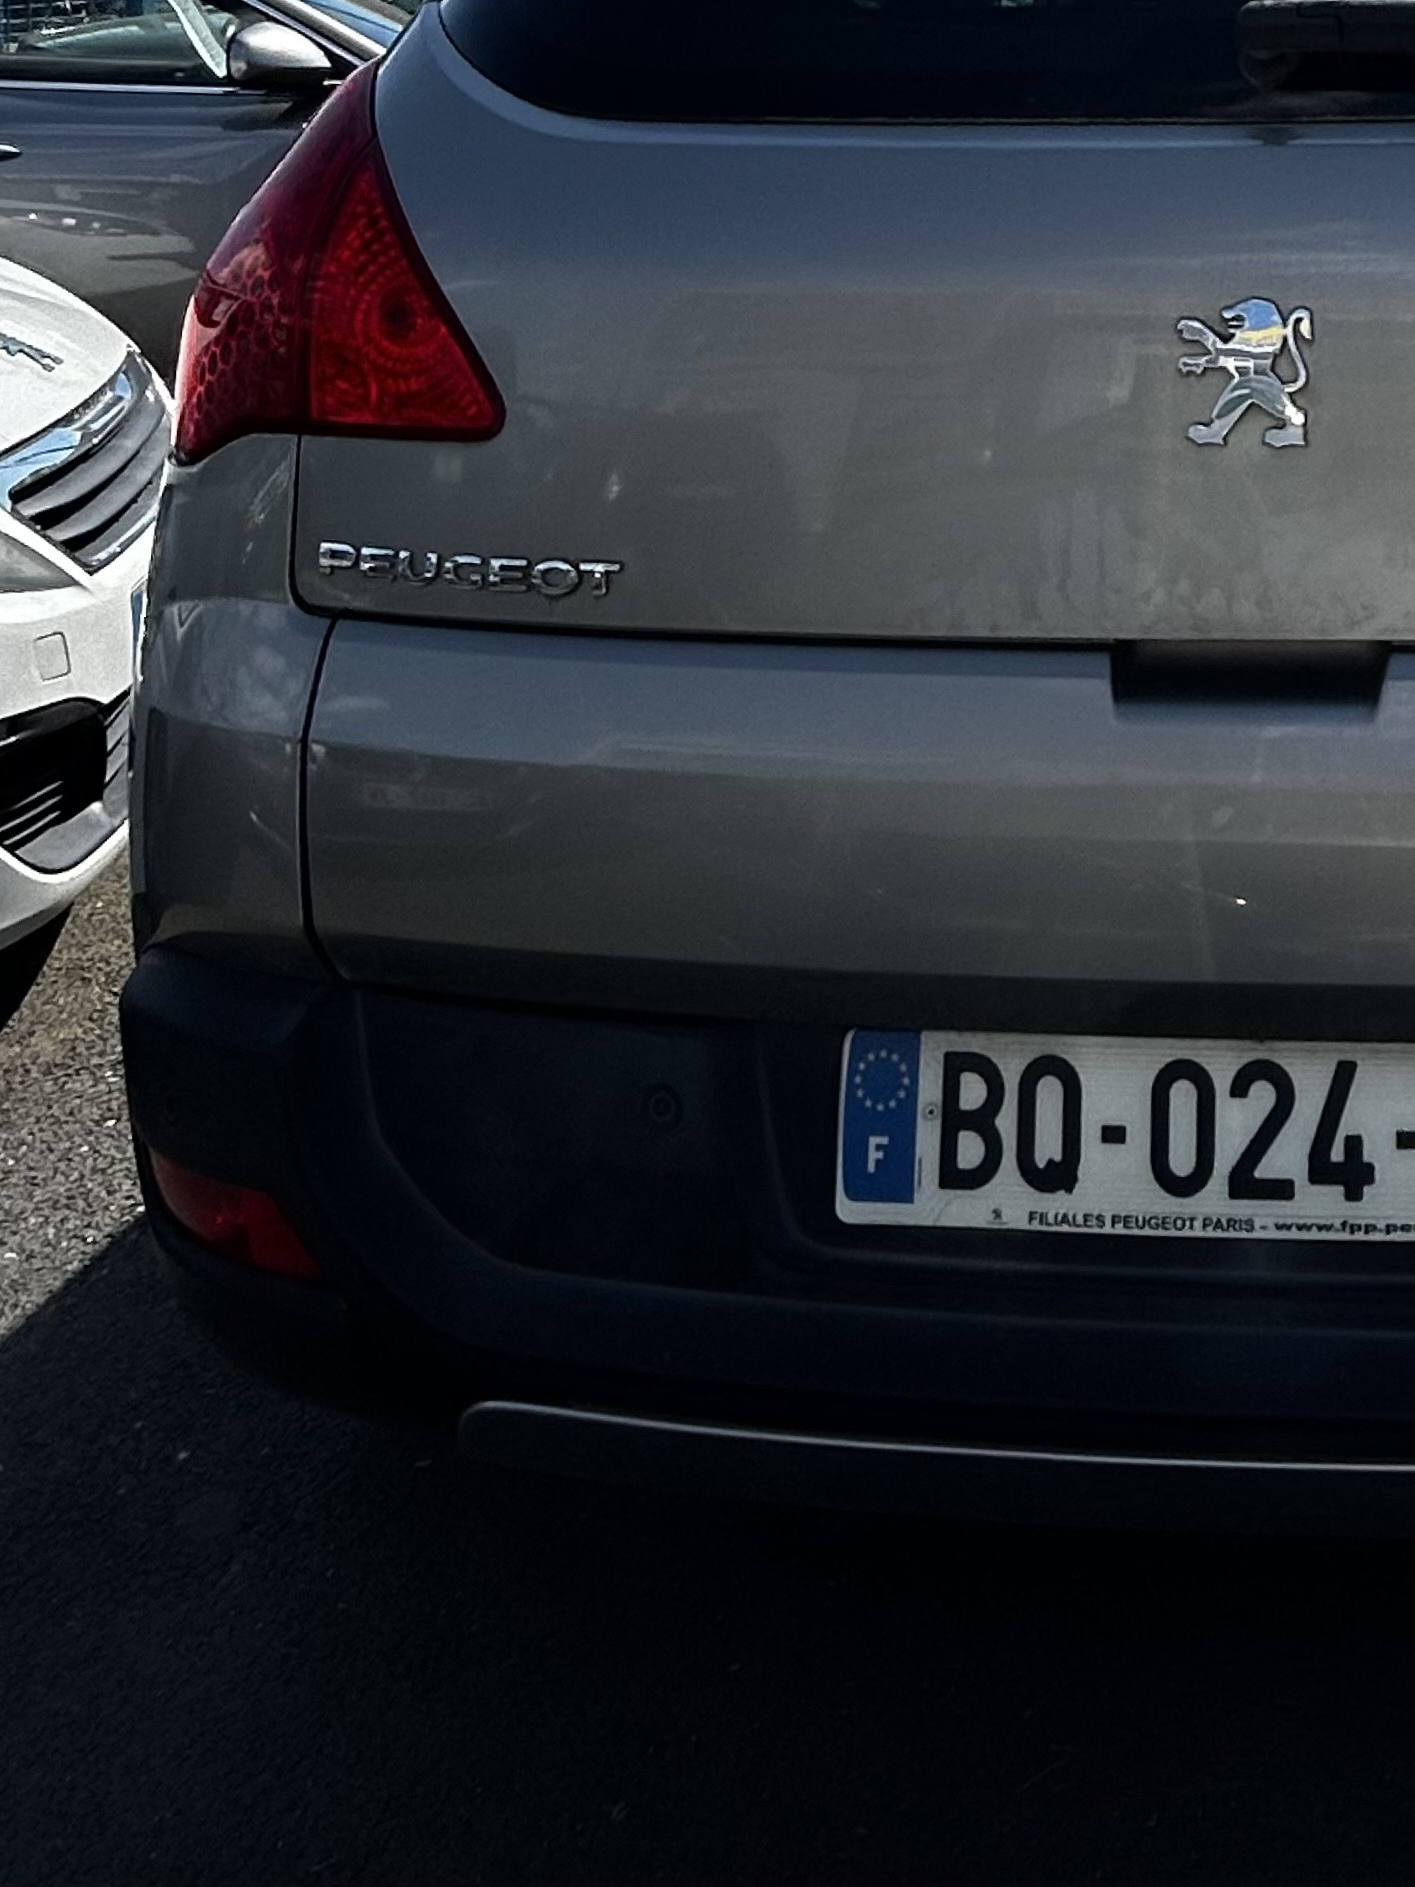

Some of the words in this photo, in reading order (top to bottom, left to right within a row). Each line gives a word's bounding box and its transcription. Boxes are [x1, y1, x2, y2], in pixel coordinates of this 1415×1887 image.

[318, 541, 622, 597] PEUGEOT
[867, 1136, 889, 1173] F
[1028, 1210, 1106, 1228] FILIALES
[1111, 1214, 1197, 1232] PEUGEOT
[1202, 1216, 1255, 1233] PARIS
